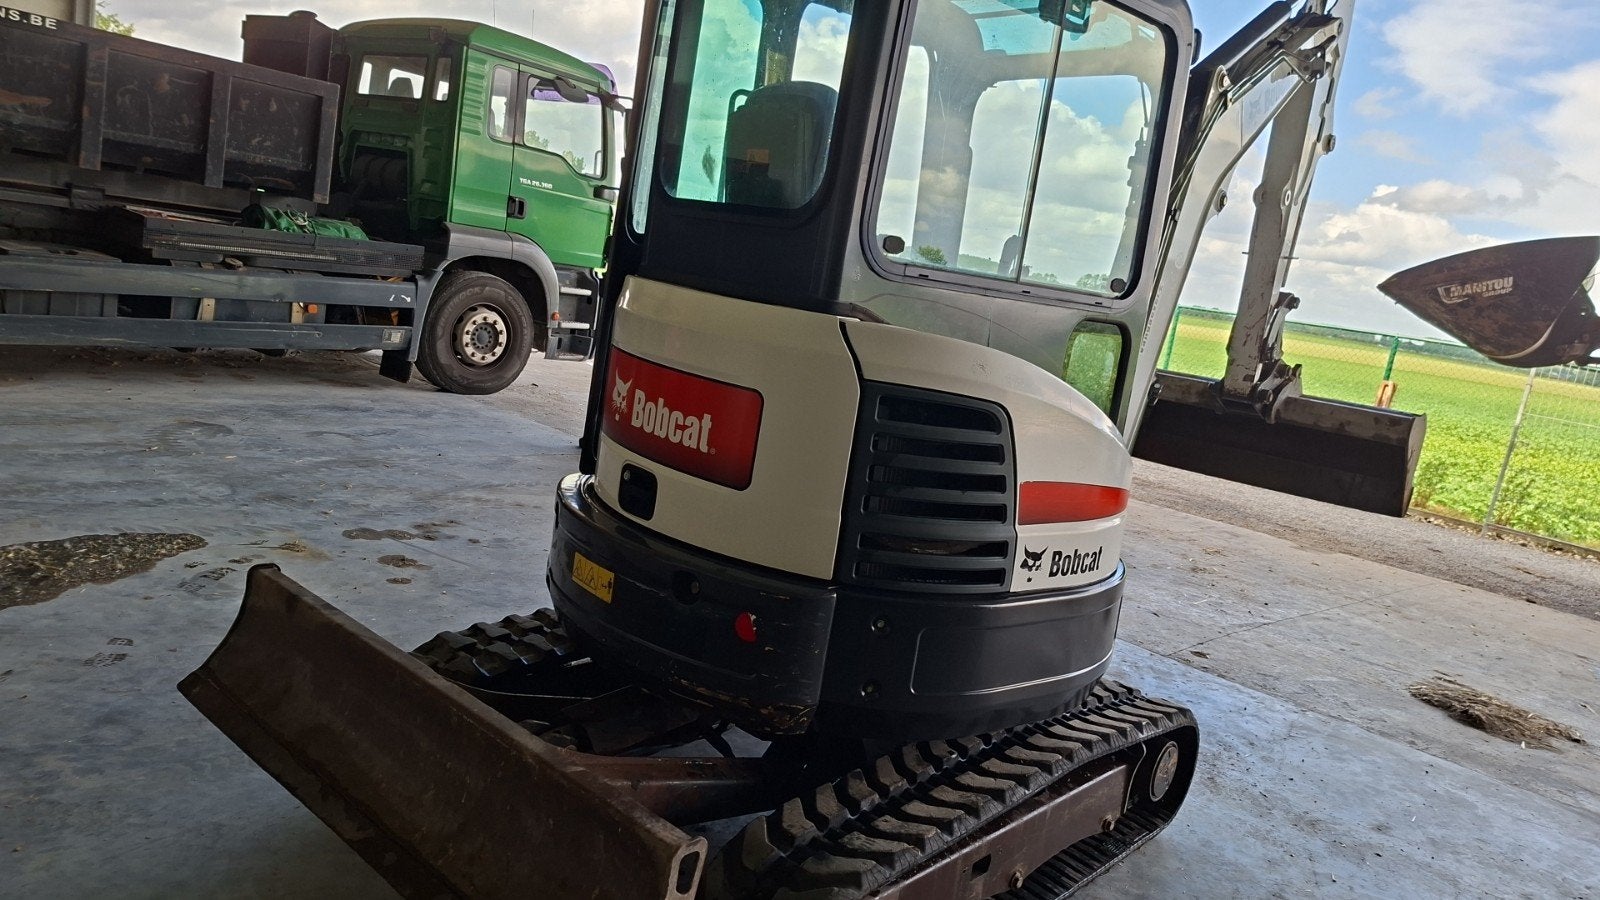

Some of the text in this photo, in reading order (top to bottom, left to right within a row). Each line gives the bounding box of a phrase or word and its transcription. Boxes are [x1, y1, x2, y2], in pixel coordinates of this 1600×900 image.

[1449, 276, 1514, 298] MANITOU
[631, 388, 712, 454] Bobcat
[1048, 545, 1104, 578] Bobcat
